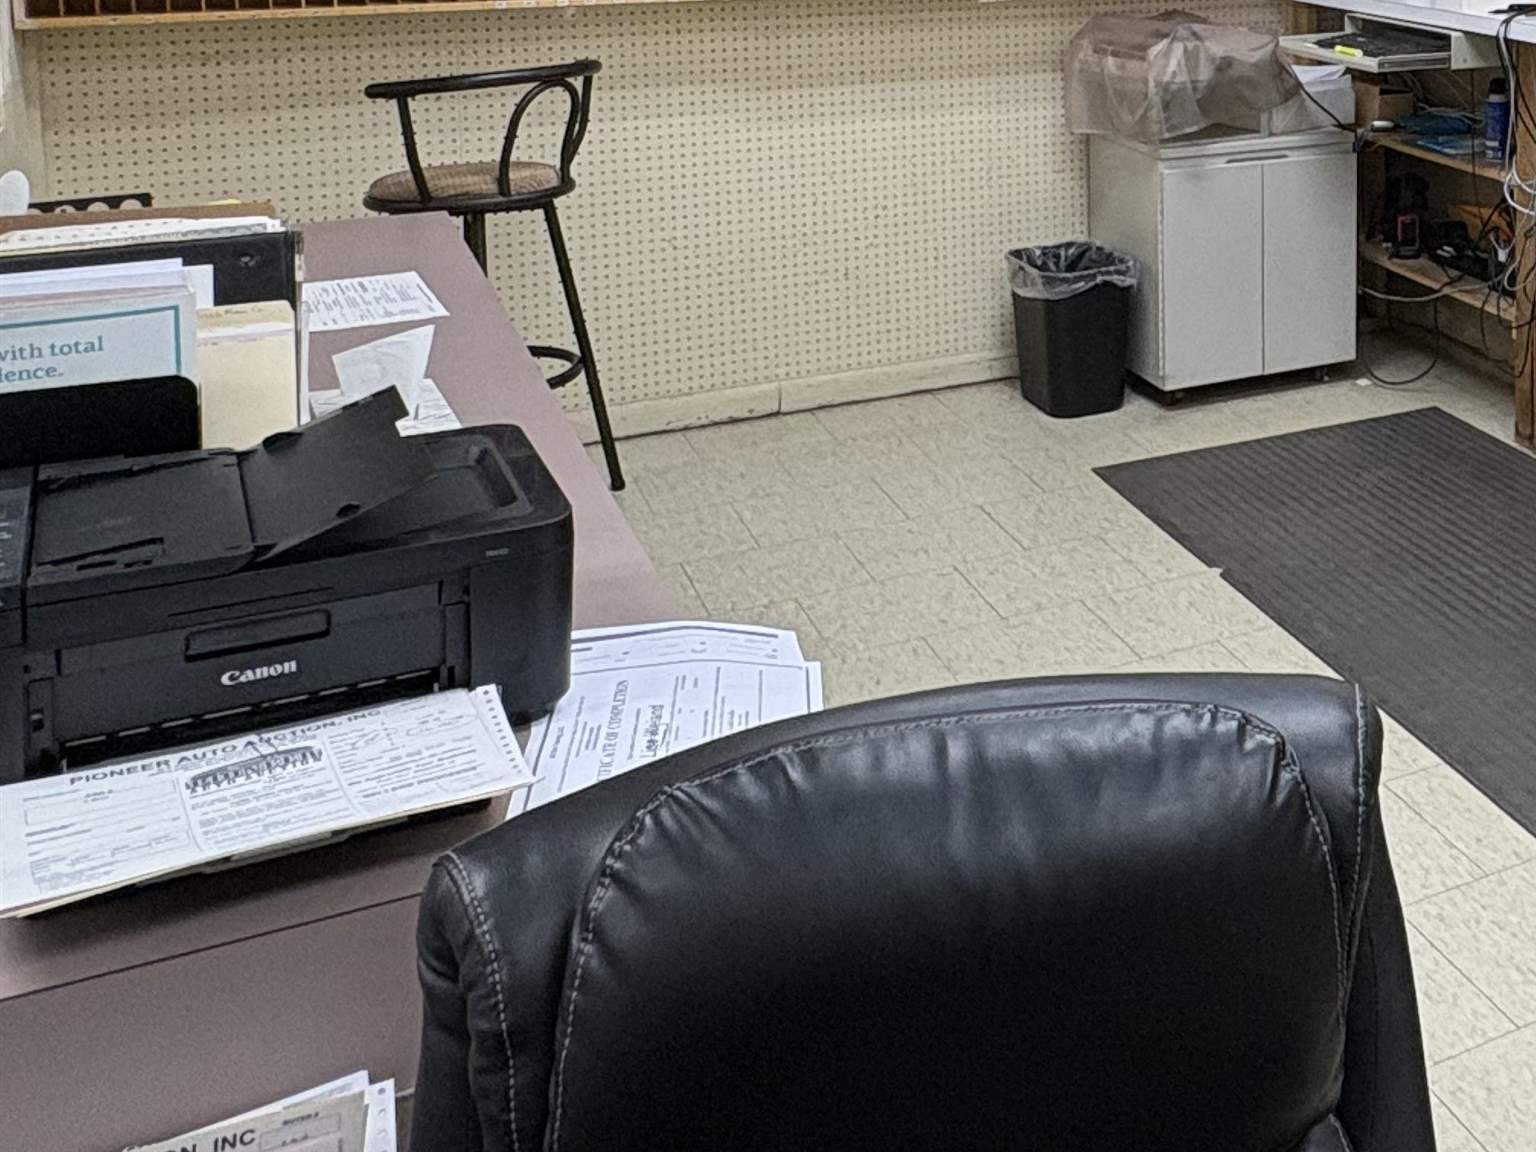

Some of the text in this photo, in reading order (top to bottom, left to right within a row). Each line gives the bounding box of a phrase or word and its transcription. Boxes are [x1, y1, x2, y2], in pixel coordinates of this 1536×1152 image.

[48, 335, 105, 357] total
[0, 365, 64, 384] ence.
[220, 659, 297, 686] Canon
[69, 758, 171, 786] PIONEER
[176, 745, 237, 766] AUTO
